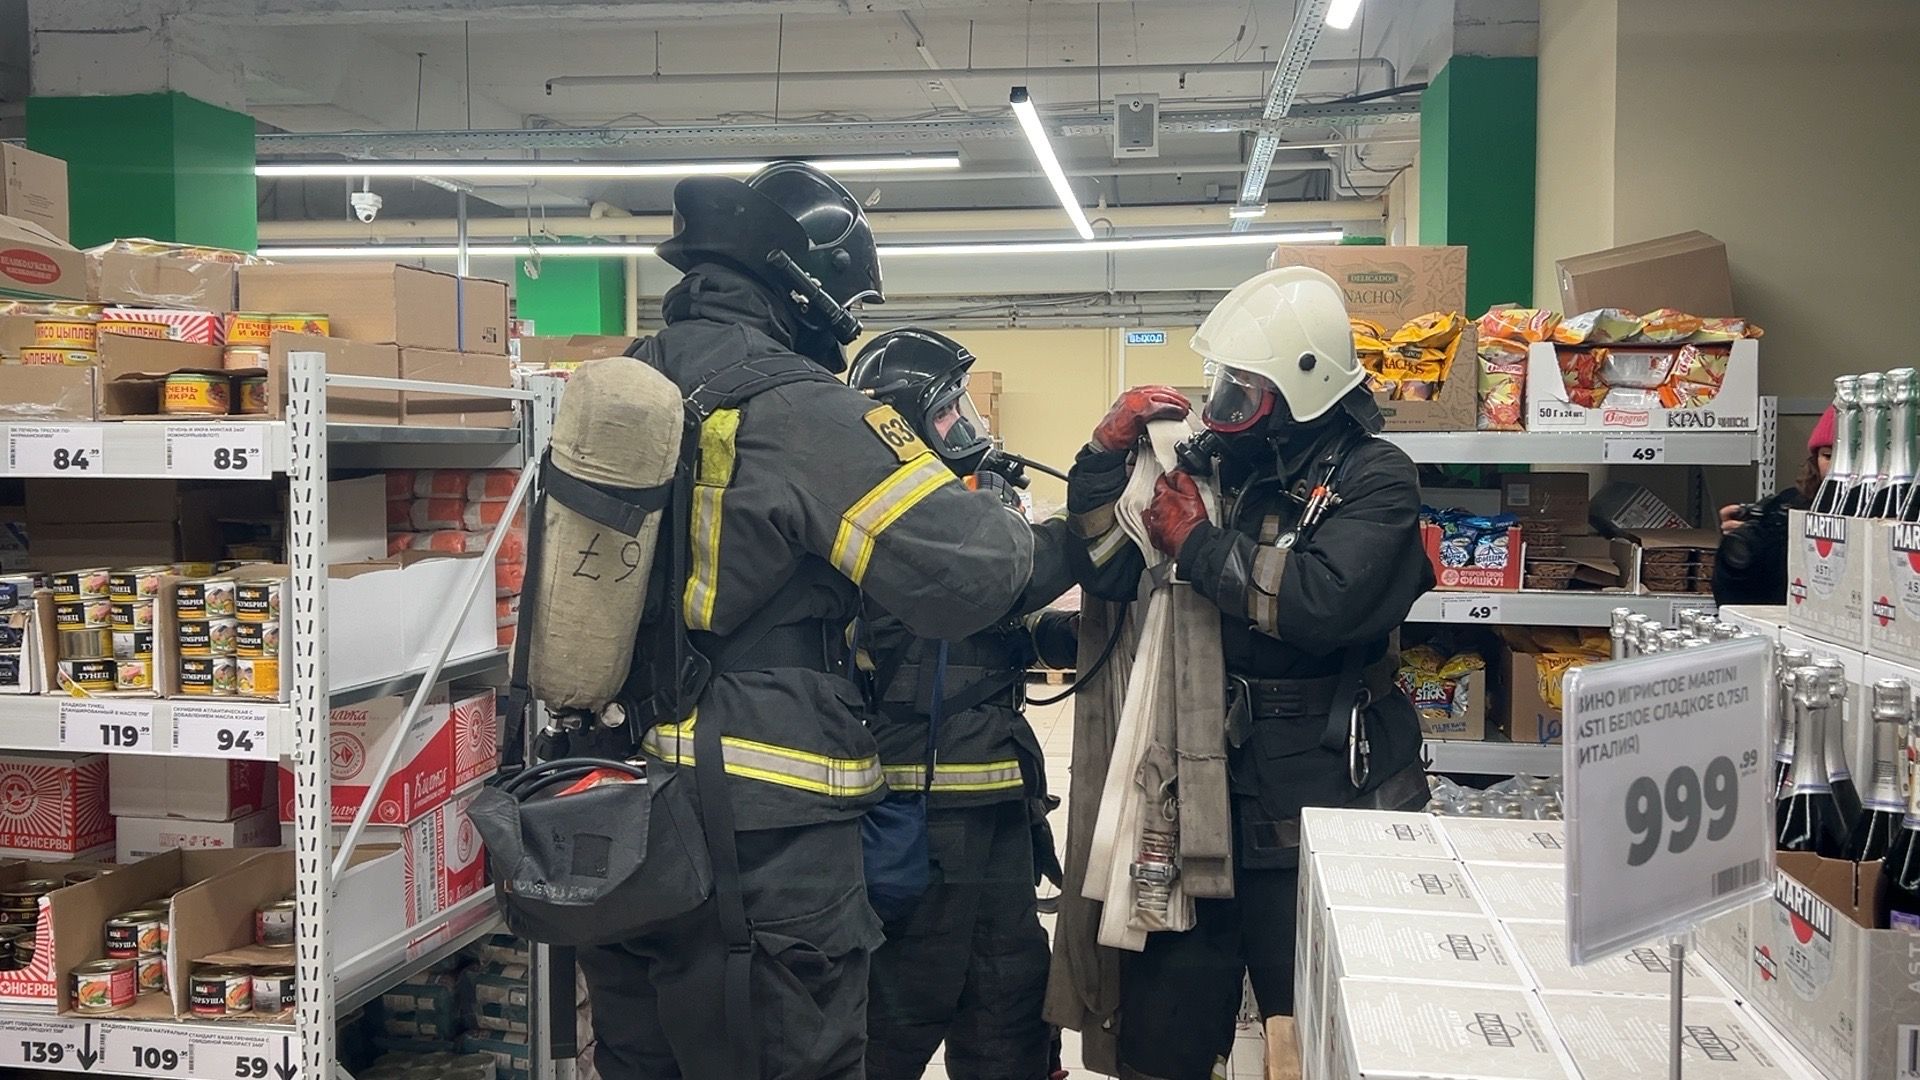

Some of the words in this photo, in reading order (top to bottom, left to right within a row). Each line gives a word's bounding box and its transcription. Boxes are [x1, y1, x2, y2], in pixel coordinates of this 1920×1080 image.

[1343, 288, 1403, 305] NACHOS
[1129, 333, 1164, 343] ВЫХОД
[21, 353, 65, 365] ЫПЛЕНКА
[1383, 357, 1425, 375] NACHOS
[1539, 407, 1552, 419] 50
[1667, 411, 1716, 428] КРАБ
[53, 448, 90, 470] 84
[213, 447, 249, 471] 85
[1632, 447, 1656, 461] 49
[1805, 513, 1846, 541] MARTINI
[1894, 523, 1920, 551] MAR
[1459, 576, 1504, 587] ФИШКУ!
[1468, 606, 1491, 618] 49
[78, 672, 110, 681] ТУНЕЦ
[1618, 675, 1686, 706] ИГРИСТОЕ
[1688, 665, 1738, 691] MARTINI
[1609, 704, 1650, 732] БЕЛОЕ
[1653, 695, 1714, 723] СЛАДКОЕ
[1716, 685, 1749, 710] 0,75Л
[99, 724, 140, 747] 119
[216, 728, 254, 752] 94
[1577, 733, 1641, 768] (ИТАЛИЯ)
[1624, 755, 1739, 867] 999
[1739, 749, 1759, 770] .99
[13, 834, 72, 851] КОНСЕРВЫ
[1775, 869, 1833, 938] MARTINI
[1788, 945, 1812, 973] ASTI
[20, 1040, 64, 1064] 139
[132, 1045, 179, 1071] 109
[234, 1055, 269, 1079] 59
